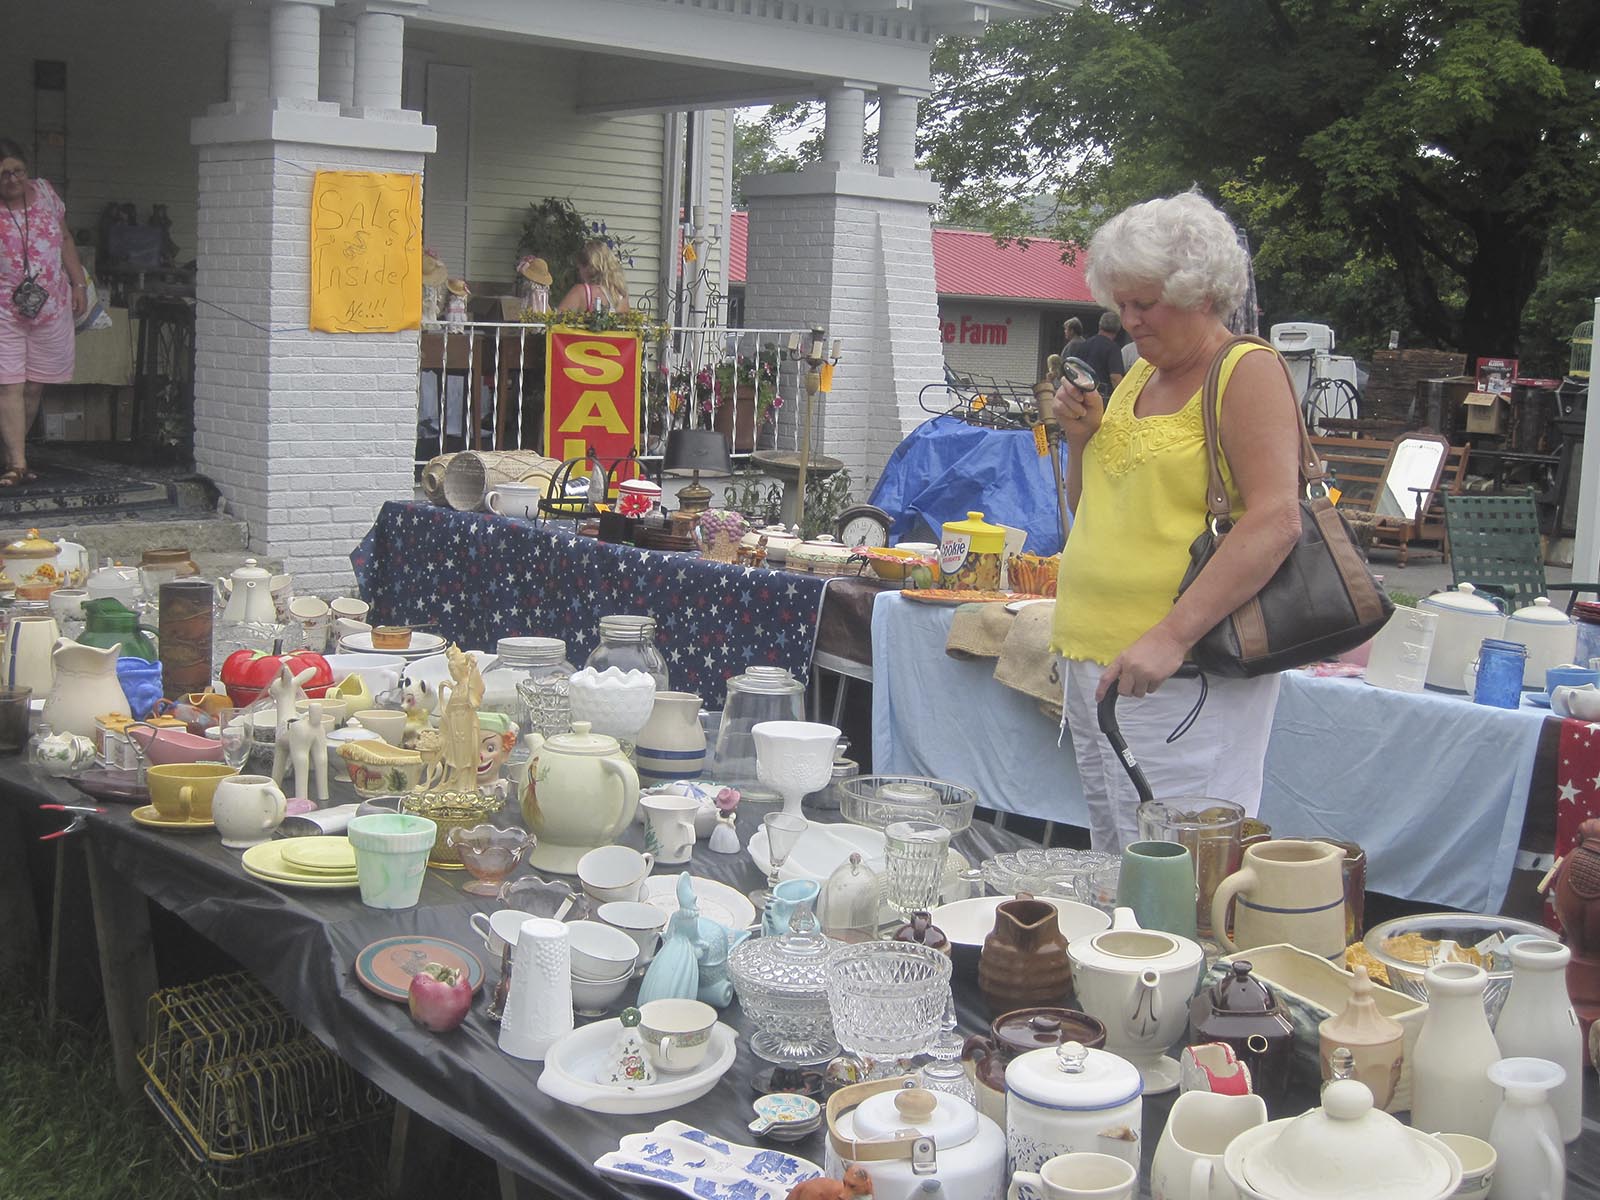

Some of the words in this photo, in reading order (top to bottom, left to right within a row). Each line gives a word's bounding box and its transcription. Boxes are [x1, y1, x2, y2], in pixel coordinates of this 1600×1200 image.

[315, 189, 400, 235] SALE
[959, 315, 1008, 345] Farm
[557, 340, 631, 498] SAL
